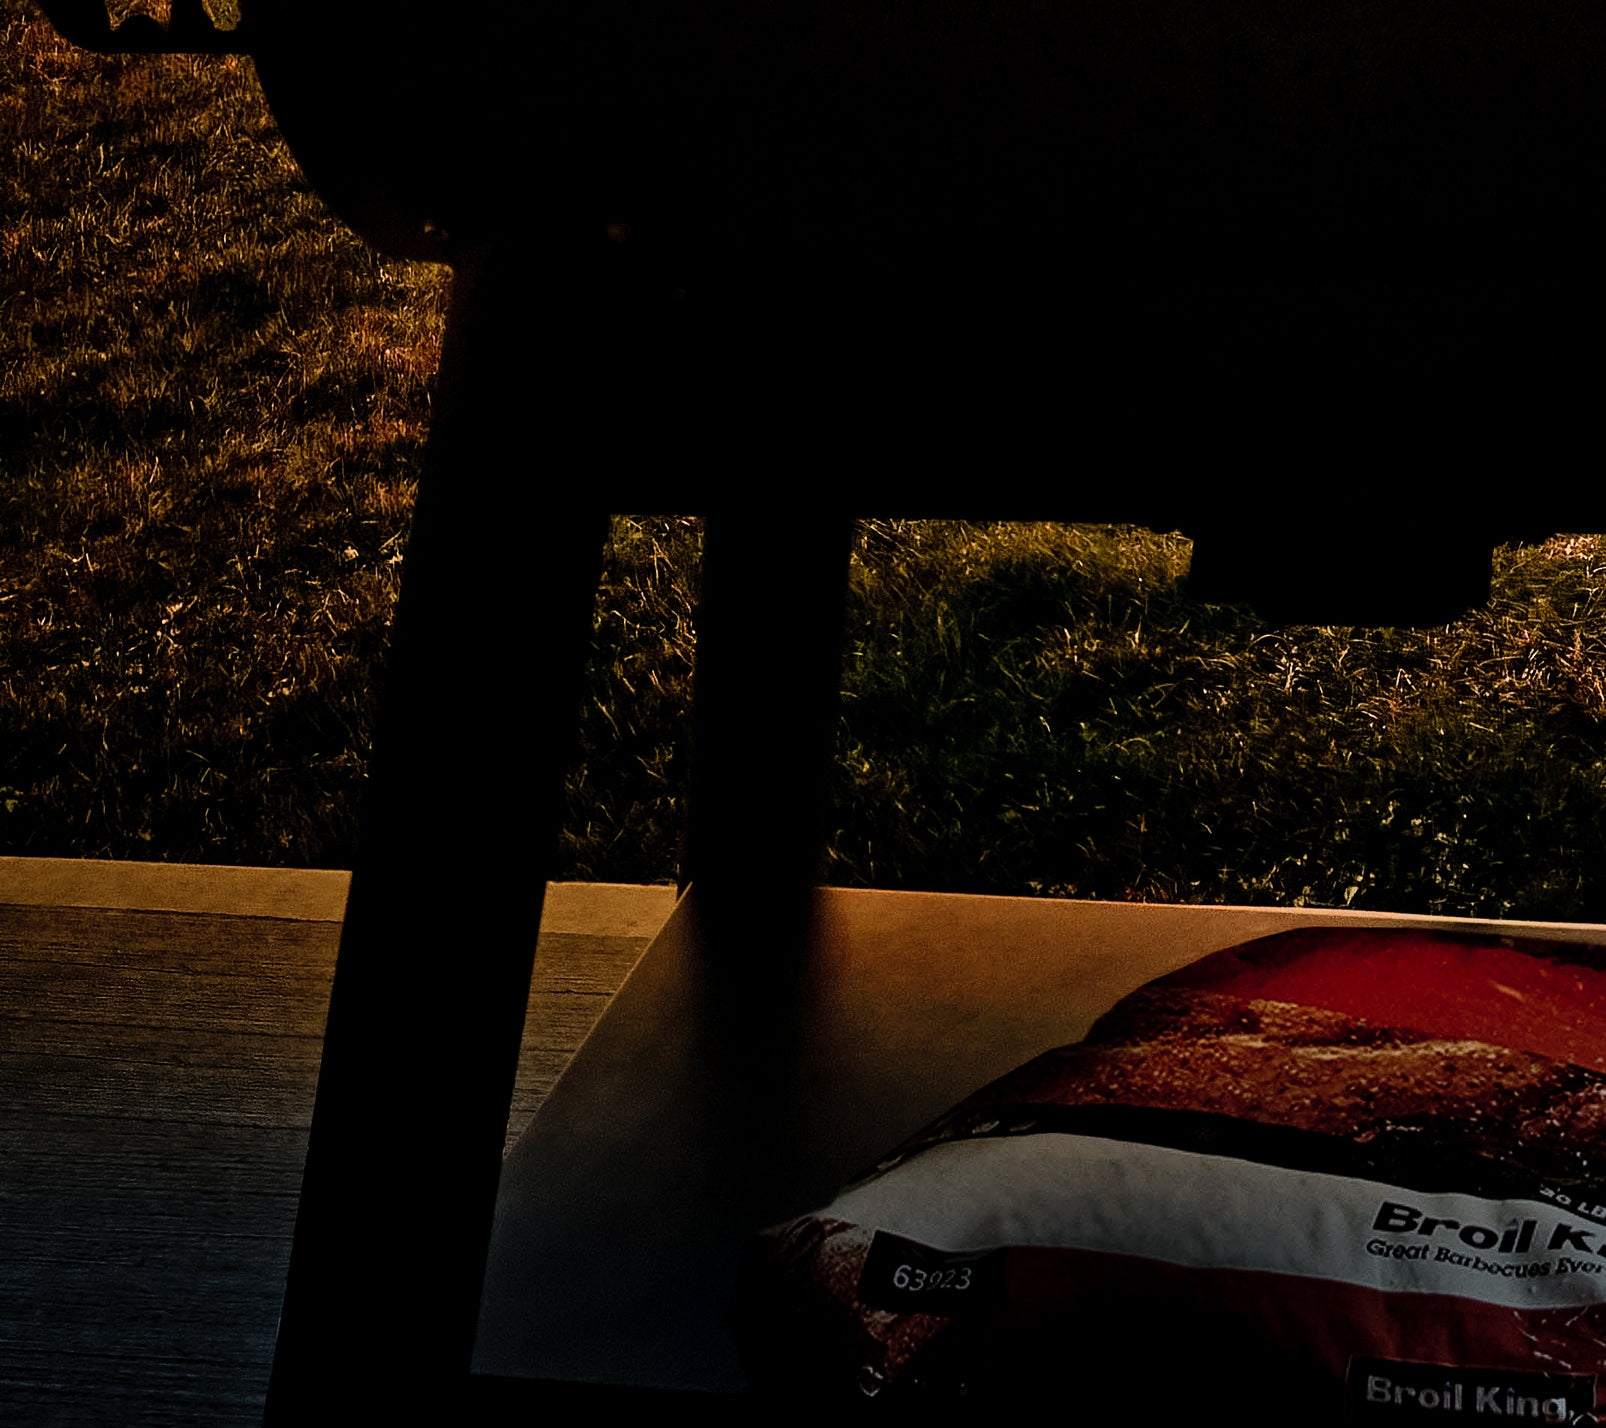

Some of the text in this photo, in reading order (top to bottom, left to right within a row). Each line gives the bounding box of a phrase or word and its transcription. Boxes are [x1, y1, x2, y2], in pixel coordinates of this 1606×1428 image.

[1366, 1238, 1429, 1260] Great
[1373, 1201, 1537, 1253] Broil
[1365, 1373, 1567, 1423] Broil King
